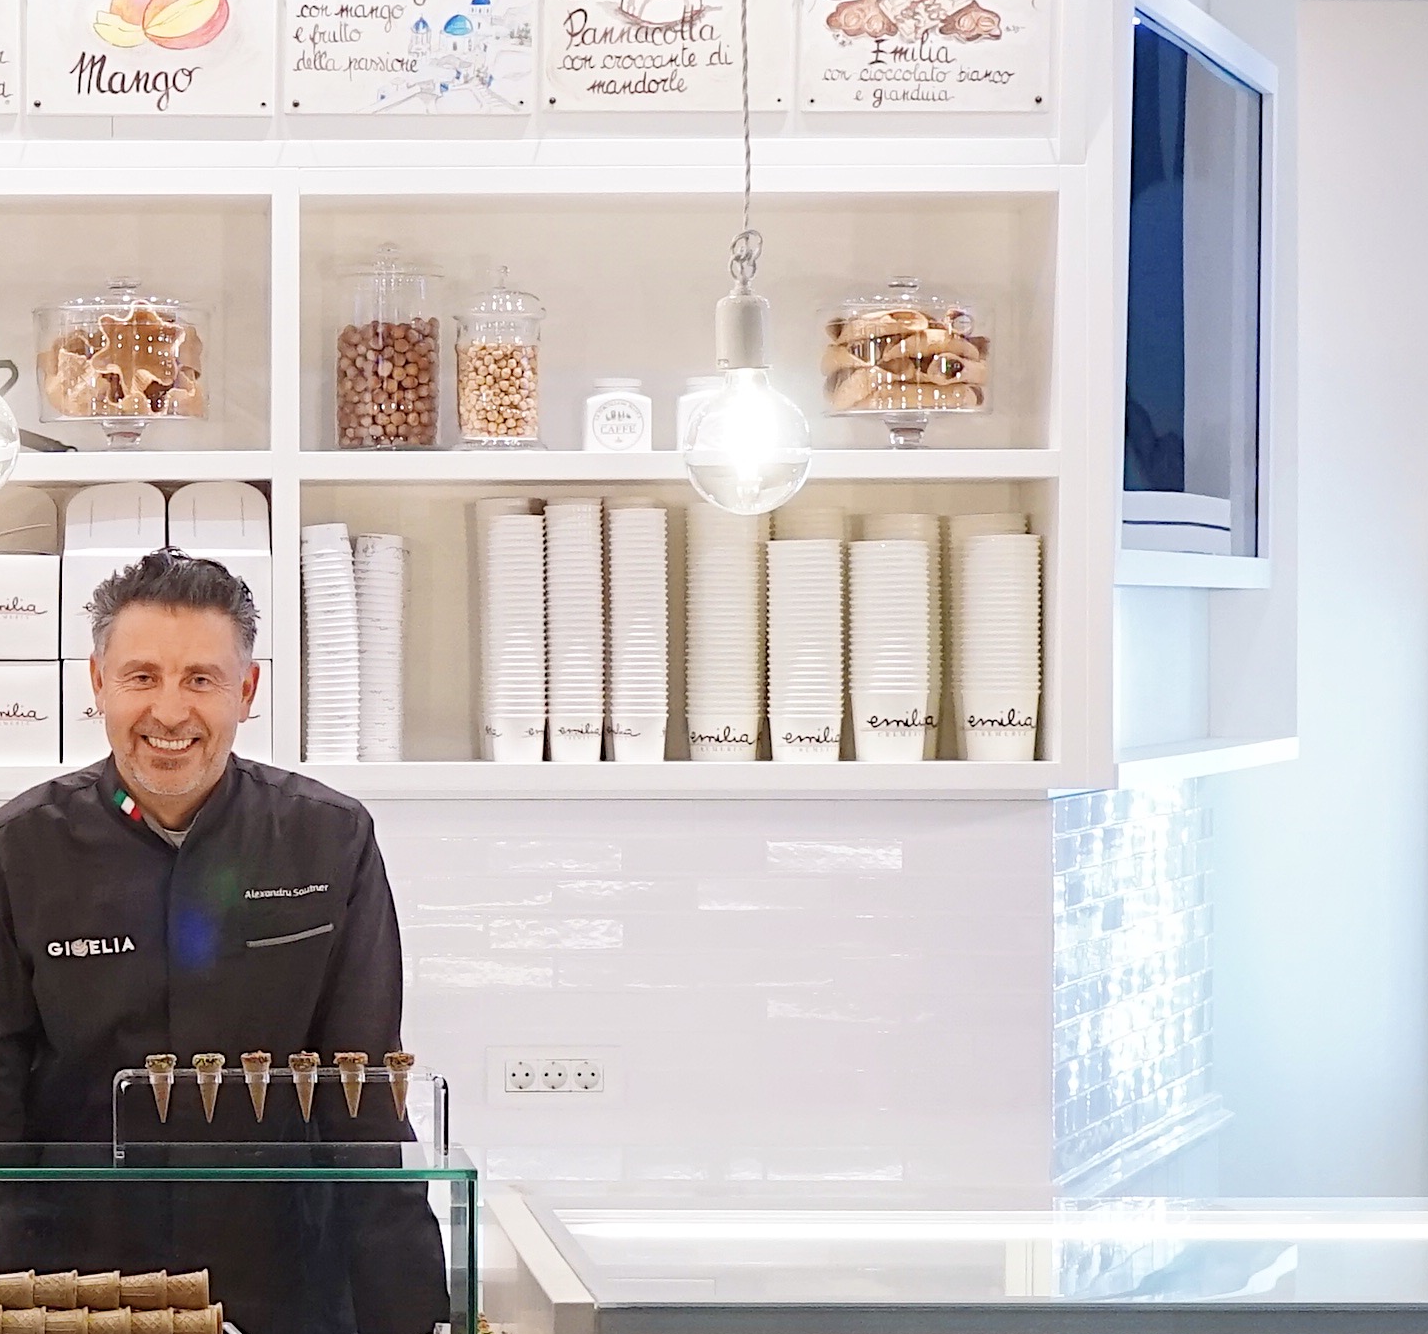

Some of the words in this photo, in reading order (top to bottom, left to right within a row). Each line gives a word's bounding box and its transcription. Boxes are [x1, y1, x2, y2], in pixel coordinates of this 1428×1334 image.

[296, 3, 336, 19] con
[337, 3, 407, 33] mango
[561, 6, 722, 49] Pannacotta
[308, 22, 363, 48] frutto
[868, 29, 956, 65] Emilia
[293, 51, 342, 73] della
[345, 55, 419, 81] passione
[557, 53, 596, 69] con
[601, 44, 698, 69] croccante
[705, 45, 734, 67] di
[70, 51, 202, 111] Mango
[586, 74, 688, 95] mandorle
[857, 62, 952, 82] cioccolato
[957, 65, 1015, 84] bianco
[872, 84, 955, 108] gianduia
[867, 709, 939, 729] emilia
[967, 708, 1036, 728] emilia
[690, 726, 755, 745] emilia
